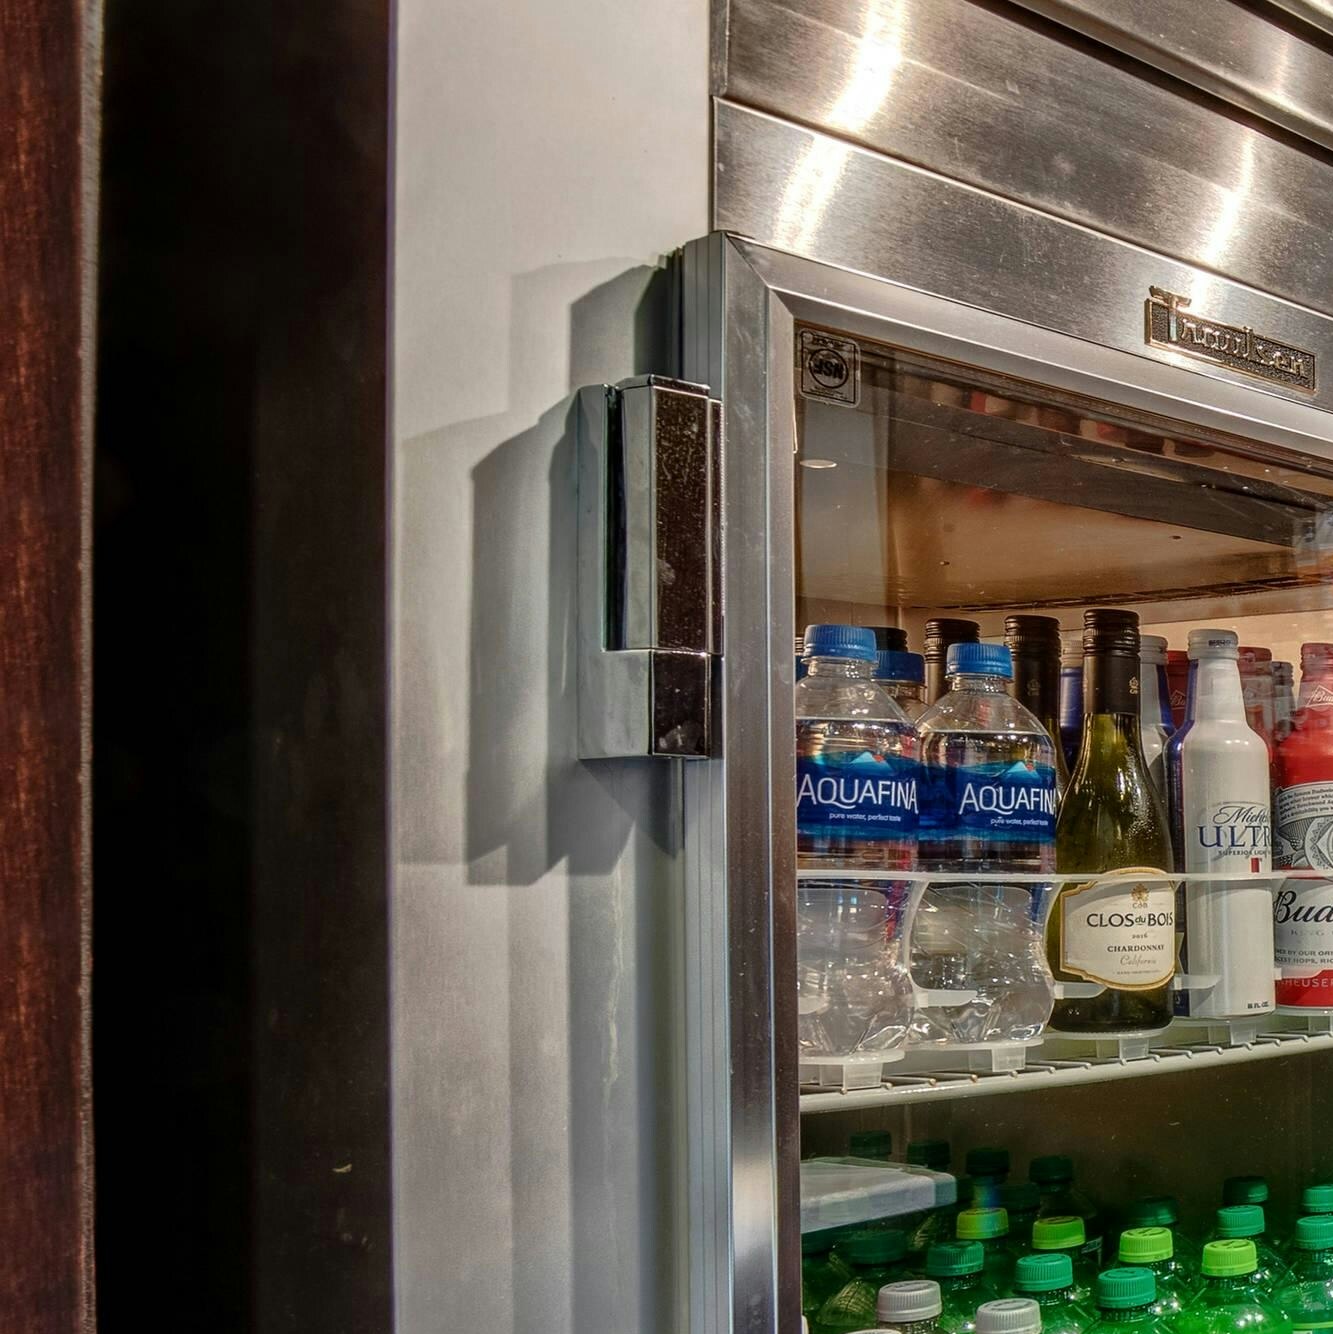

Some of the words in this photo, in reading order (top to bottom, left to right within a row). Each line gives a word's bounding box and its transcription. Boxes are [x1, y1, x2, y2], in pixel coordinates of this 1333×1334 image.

[795, 773, 919, 814] AQUAFINA
[958, 782, 1057, 816] AQUAFIN
[1087, 913, 1134, 927] CLOS
[1135, 915, 1146, 925] du
[1148, 912, 1173, 926] BOIS
[1107, 944, 1164, 953] CHARDONNAY
